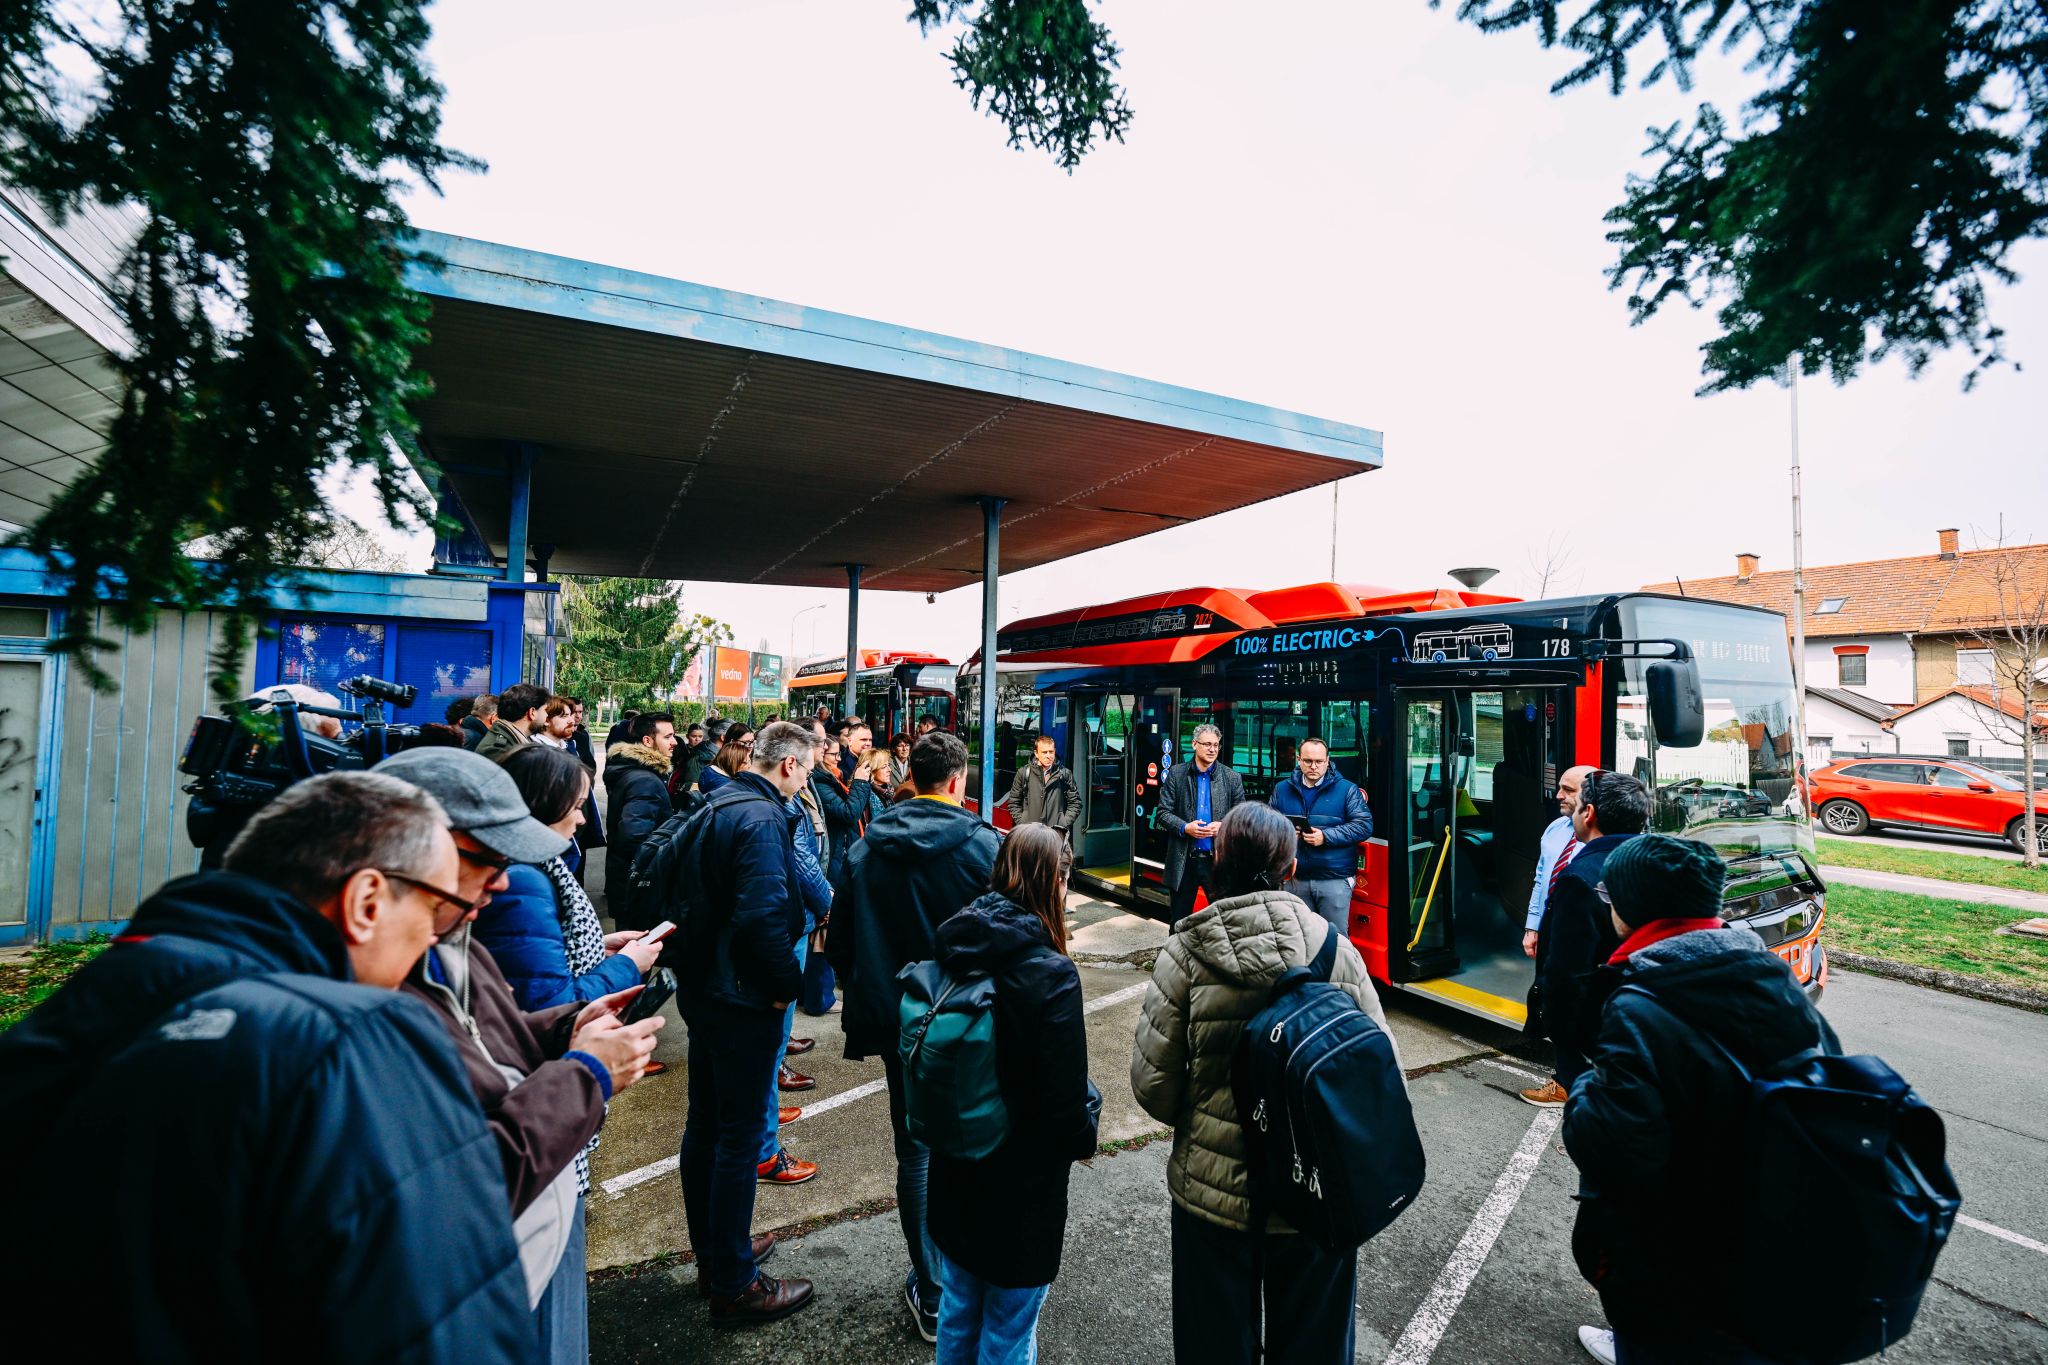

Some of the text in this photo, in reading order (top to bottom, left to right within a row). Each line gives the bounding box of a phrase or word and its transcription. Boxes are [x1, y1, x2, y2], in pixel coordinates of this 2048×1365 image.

[1195, 613, 1213, 625] 2025
[1234, 627, 1354, 655] 100% ELECTRIC
[1542, 638, 1570, 657] 178
[720, 668, 742, 680] vedno
